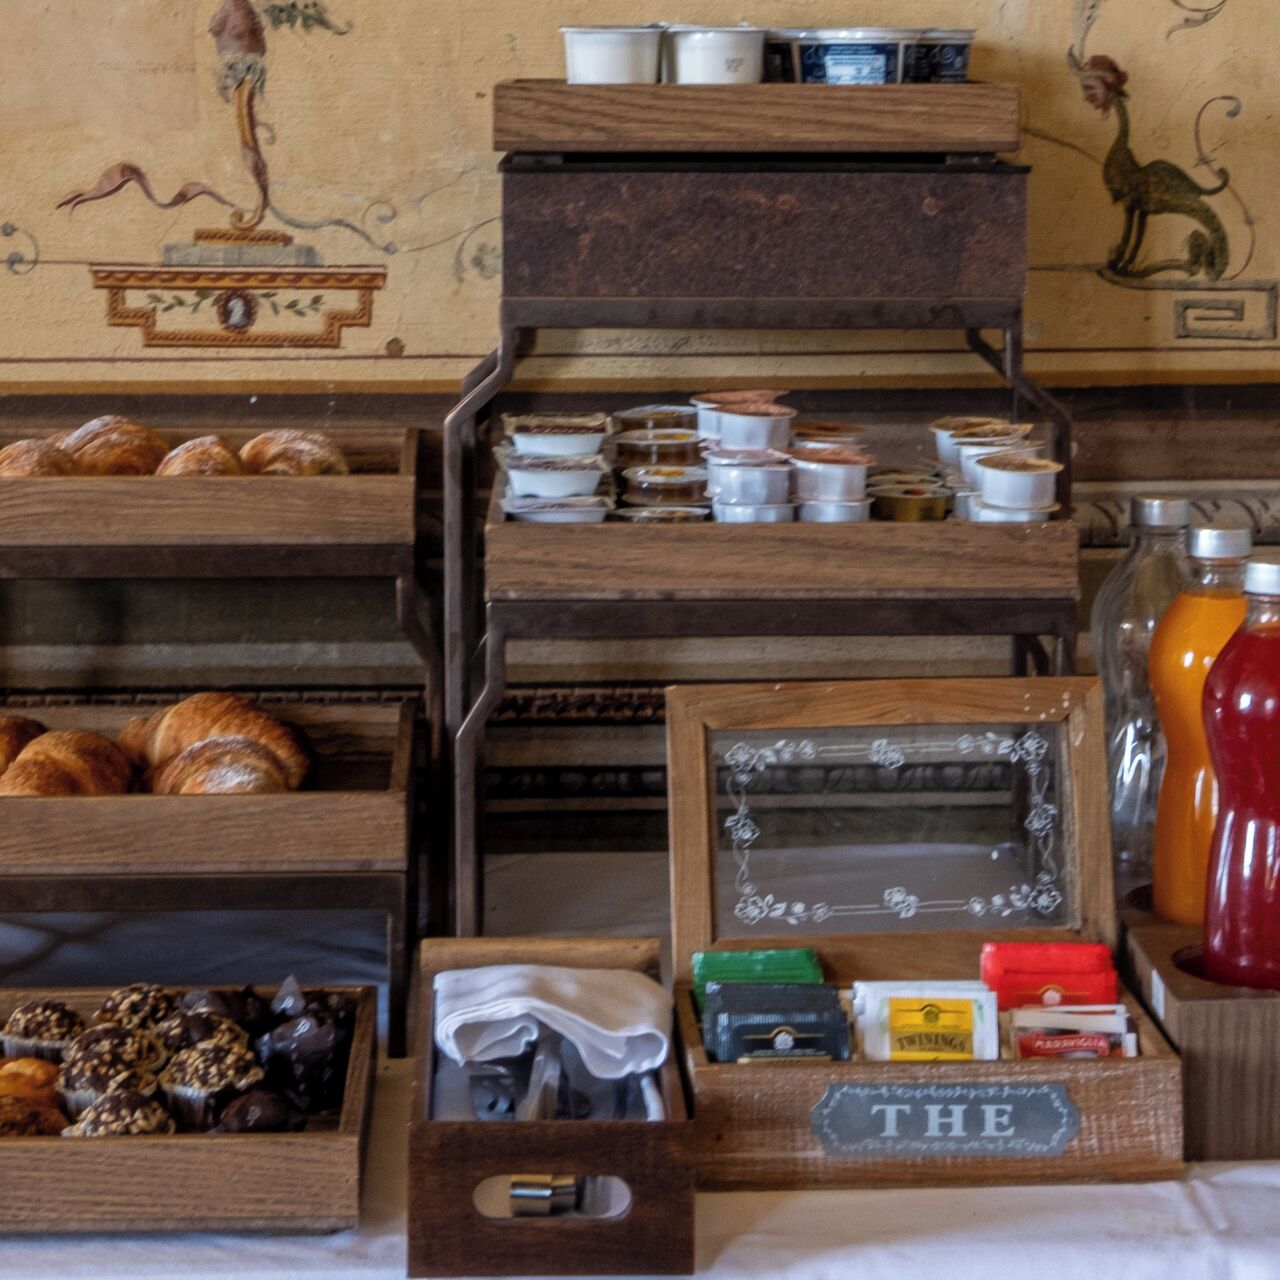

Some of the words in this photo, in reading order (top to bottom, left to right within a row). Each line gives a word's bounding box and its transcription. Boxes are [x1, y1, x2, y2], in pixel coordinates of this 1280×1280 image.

[896, 1032, 967, 1052] TWININGS
[1033, 1036, 1108, 1050] MARAVIGLIA
[870, 1104, 1016, 1138] THE
